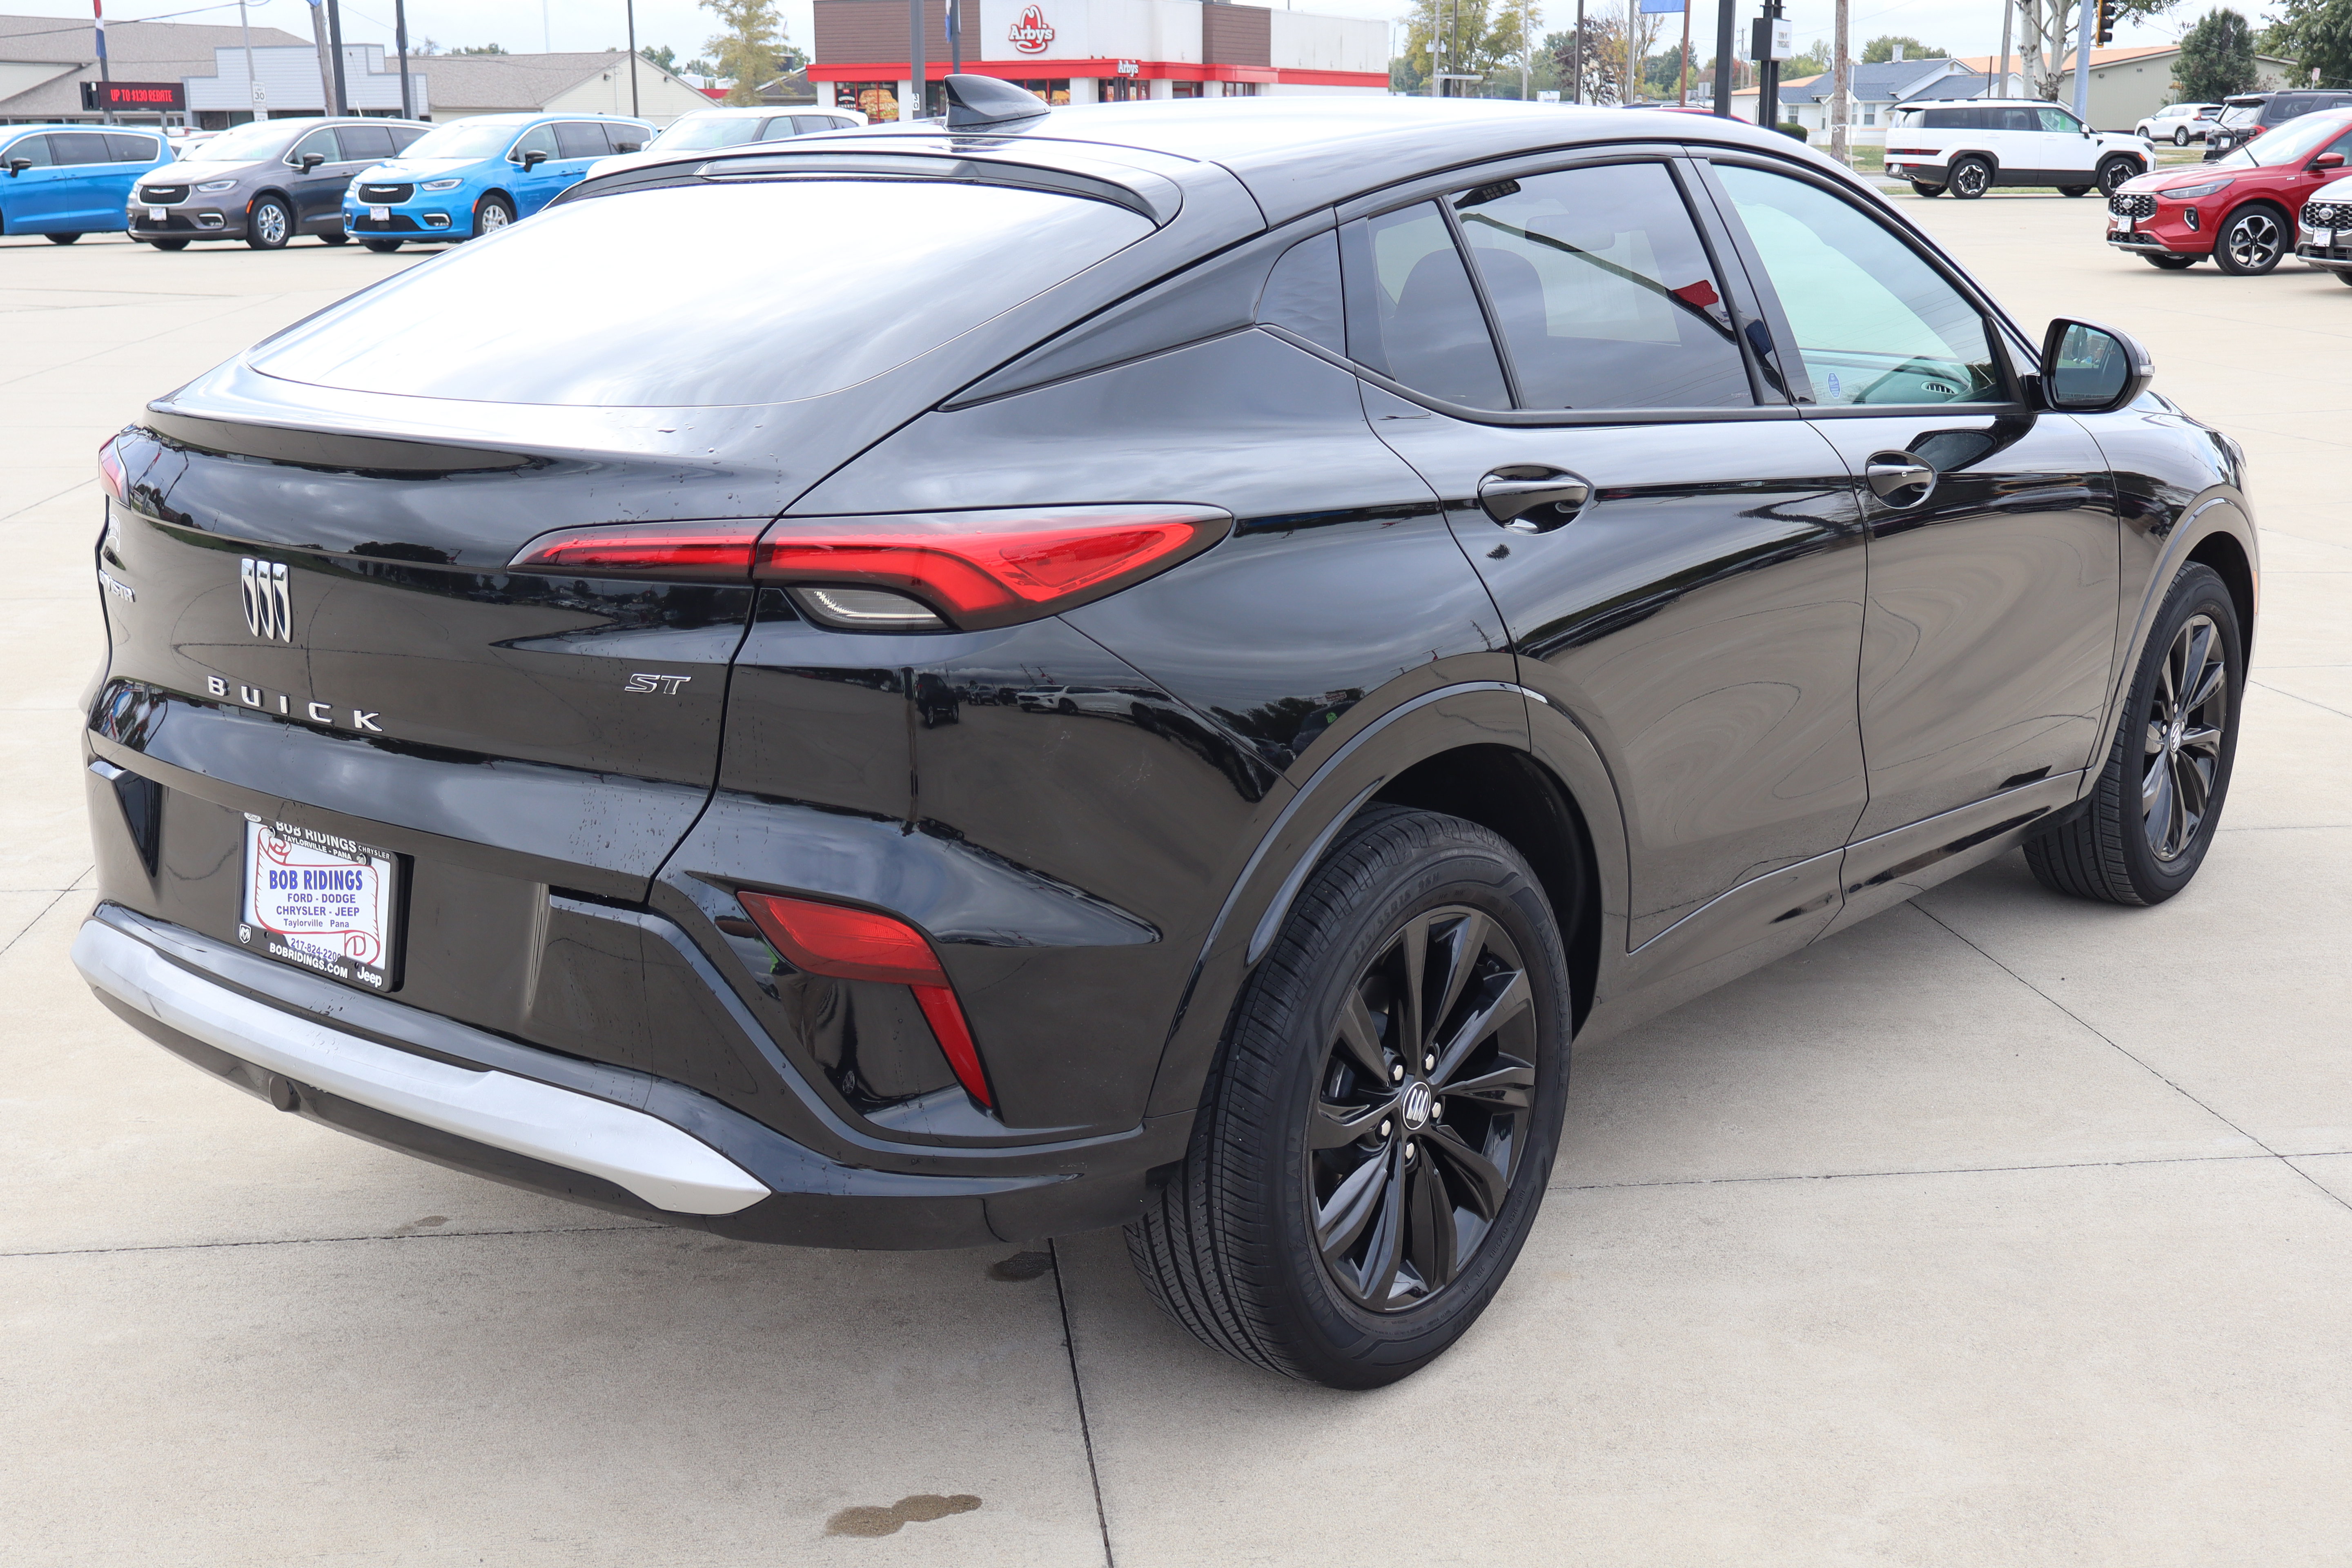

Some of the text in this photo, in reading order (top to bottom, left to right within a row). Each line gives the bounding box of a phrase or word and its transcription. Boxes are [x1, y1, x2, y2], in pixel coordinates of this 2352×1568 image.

[1009, 23, 1053, 44] Arby's
[1118, 60, 1139, 77] Arby's
[111, 89, 173, 102] UP TO $130 REBATE
[254, 91, 265, 100] 30
[624, 673, 691, 695] ST
[208, 676, 383, 732] BUICK
[247, 813, 259, 821] Ford
[276, 821, 357, 853] BOB RIDINGS
[283, 833, 327, 853] TAYLORVILLE
[333, 849, 352, 860] PANA
[358, 845, 391, 860] CHRYSLER
[269, 870, 363, 891] BOB RIDINGS
[287, 893, 313, 903] FORD
[322, 893, 356, 904] DODGE
[276, 906, 326, 916] CHRYSLER
[335, 907, 360, 917] JEEP
[283, 918, 350, 928] Taylorville Pana
[270, 942, 348, 979] BOBRIDINGS.COM
[357, 967, 382, 988] Jeep
